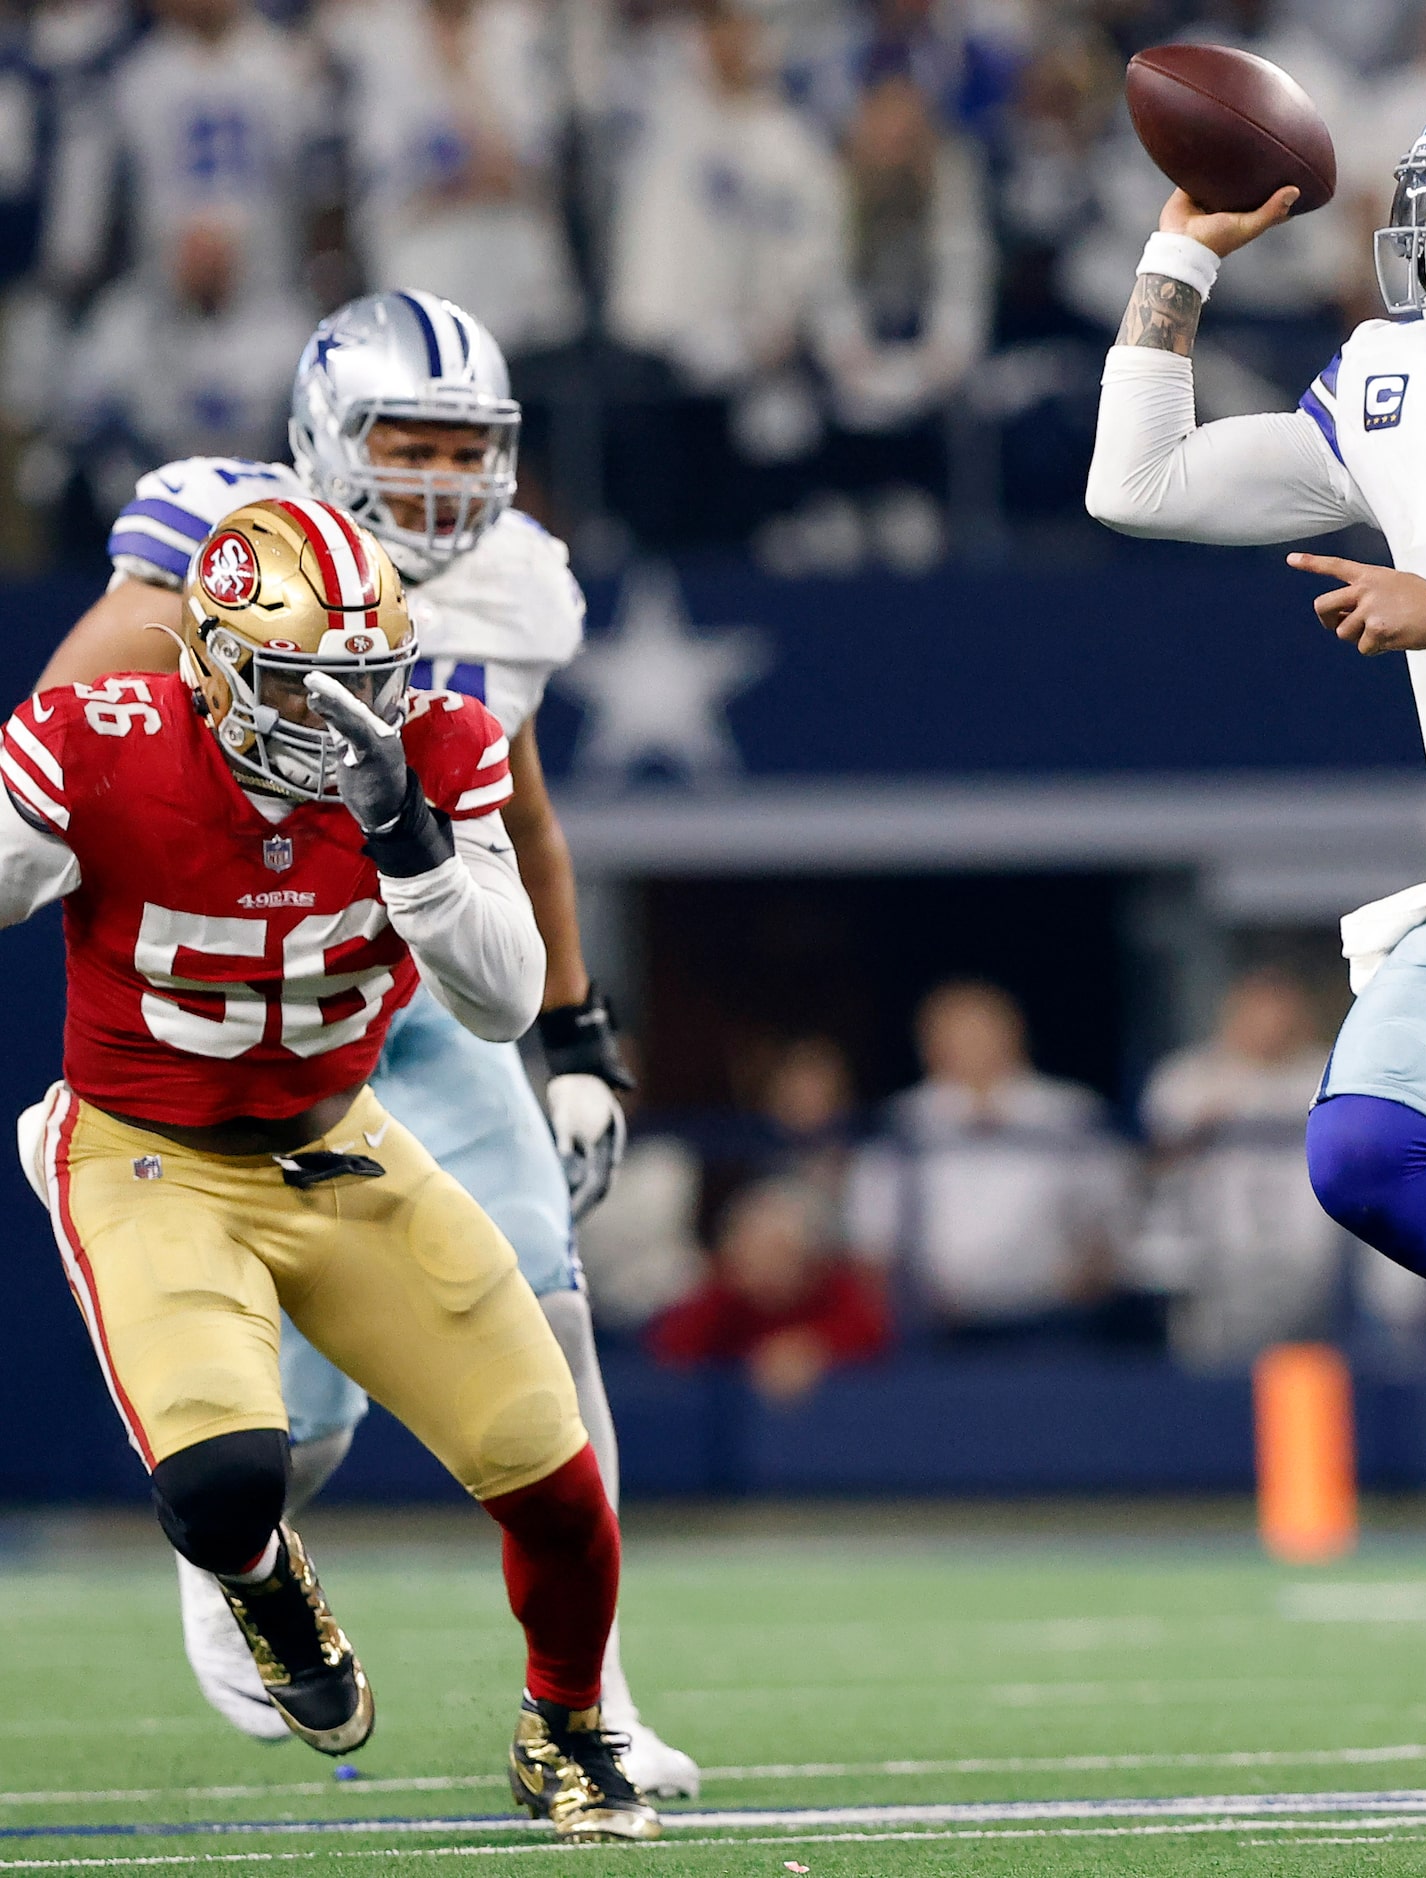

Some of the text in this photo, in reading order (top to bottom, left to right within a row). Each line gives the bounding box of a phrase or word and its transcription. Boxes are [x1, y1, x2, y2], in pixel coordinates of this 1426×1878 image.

[1366, 376, 1405, 416] C
[72, 677, 162, 738] 56
[236, 889, 316, 909] 49ERS
[134, 898, 395, 1060] 56
